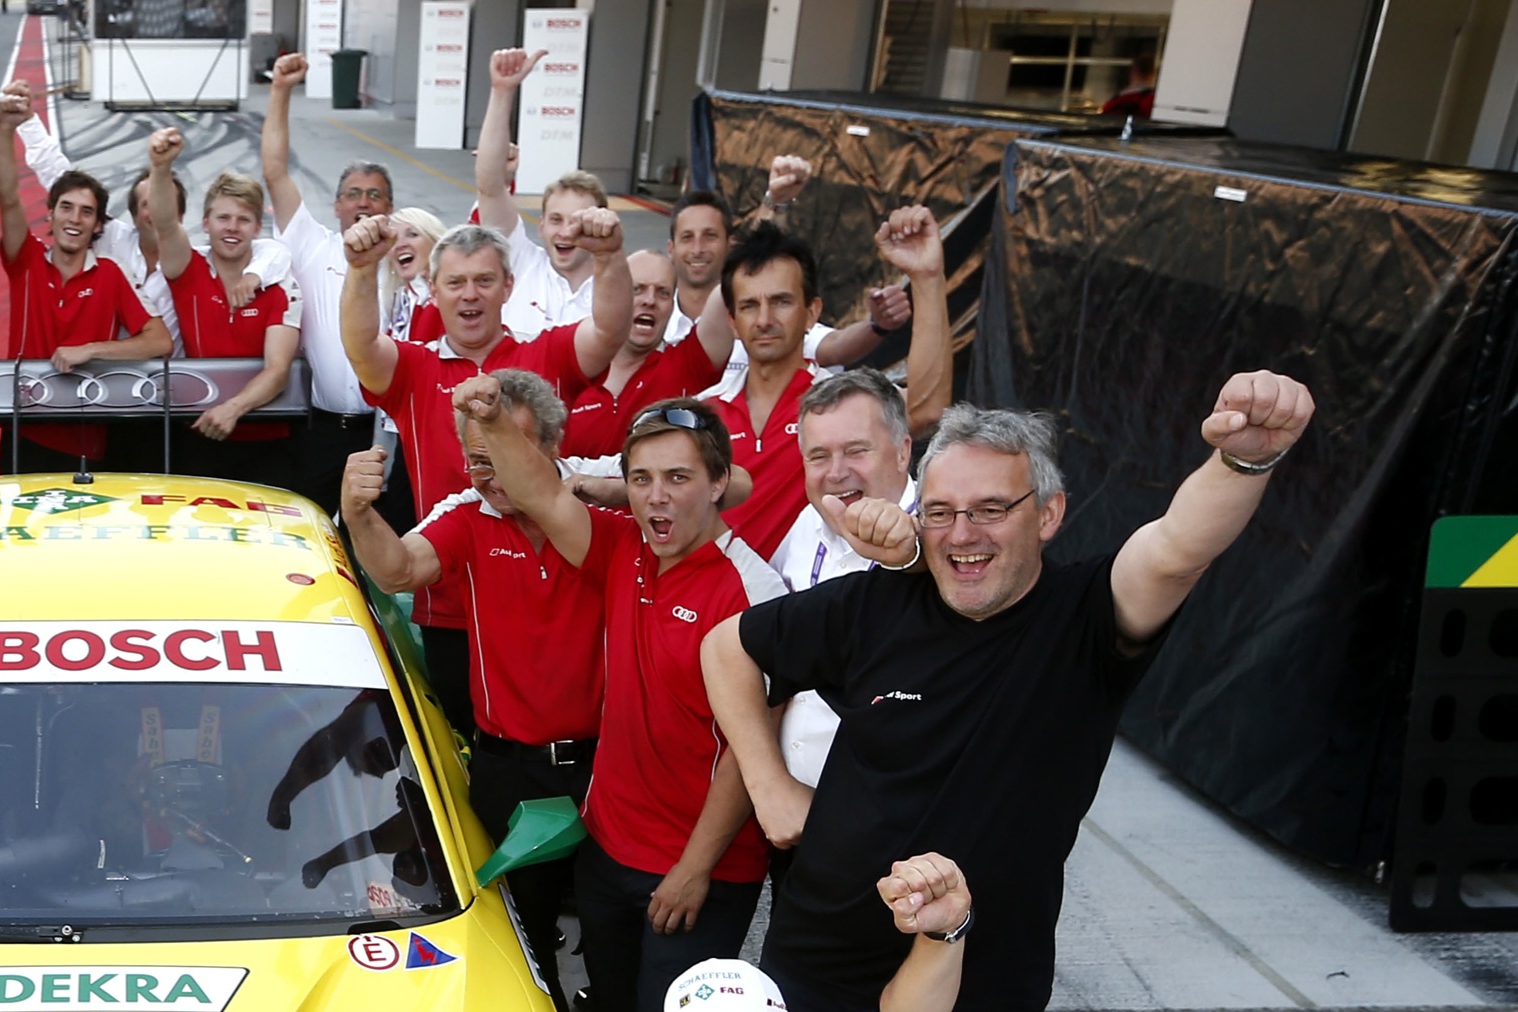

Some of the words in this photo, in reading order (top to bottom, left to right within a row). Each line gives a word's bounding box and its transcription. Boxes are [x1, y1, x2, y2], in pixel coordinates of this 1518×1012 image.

[141, 495, 303, 517] FAG
[894, 690, 922, 701] Sport
[678, 971, 742, 991] SCHAEFFLER
[719, 986, 745, 996] FAG
